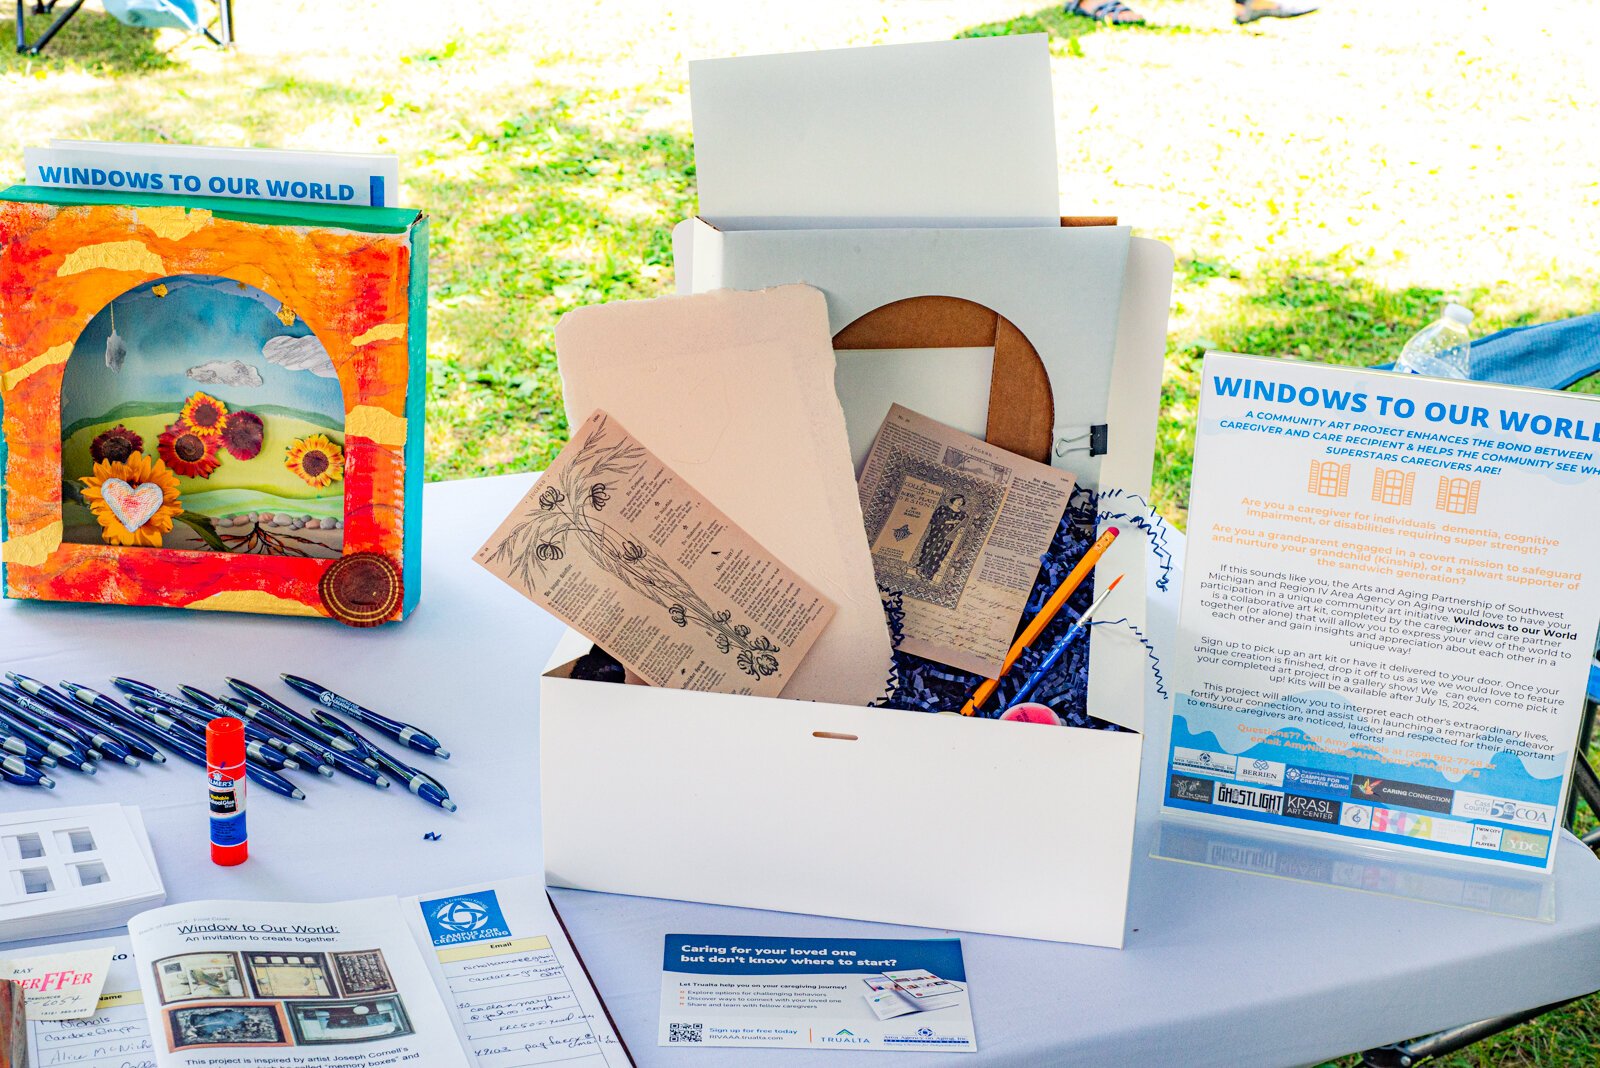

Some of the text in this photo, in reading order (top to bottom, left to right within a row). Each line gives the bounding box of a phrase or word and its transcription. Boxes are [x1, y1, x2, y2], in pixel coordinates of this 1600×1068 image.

[38, 165, 354, 200] WINDOWS TO OUR WORLD
[1214, 376, 1366, 414] WINDOWS
[1375, 395, 1414, 419] TO
[1424, 401, 1489, 428] OUR
[1246, 410, 1593, 460] A COMMUNITY ART PROJECT ENHANCES THE BOND BETWEEN
[1220, 420, 1282, 435] CAREGIVER
[1284, 428, 1309, 439] AND
[1312, 432, 1342, 443] CARE
[1345, 436, 1404, 451] RECIPIENT
[1406, 444, 1413, 452] &
[1416, 445, 1453, 457] HELPS
[1456, 450, 1478, 460] THE
[1481, 453, 1554, 470] COMMUNITY
[1555, 463, 1577, 473] SEE
[1325, 446, 1502, 475] SUPERSTARS CAREGIVERS ARE!
[1242, 497, 1261, 508] Are
[1263, 502, 1284, 512] you
[1297, 506, 1350, 519] caregiver
[1352, 512, 1369, 522] for
[1372, 514, 1436, 530] individuals
[1442, 523, 1501, 540] dementia,
[1503, 533, 1560, 546] cognitive
[1246, 508, 1315, 527] impairment,
[1332, 519, 1395, 535] disabilities
[1397, 529, 1451, 544] requiring
[1454, 536, 1487, 547] super
[1490, 540, 1548, 554] strength?
[1200, 582, 1263, 596] participation
[1266, 589, 1275, 598] in
[1287, 593, 1322, 605] unique
[1325, 599, 1384, 615] community
[1387, 607, 1400, 615] art
[1404, 610, 1451, 623] initiative.
[1453, 614, 1504, 629] Windows
[1507, 622, 1518, 631] to
[1521, 626, 1540, 634] our
[1543, 627, 1577, 639] World
[1350, 640, 1412, 656] unique way!
[1270, 675, 1480, 712] up! Kits will be available after July 15, 2024.
[1187, 697, 1555, 760] to ensure caregivers are noticed, lauded and respected for their important
[1350, 731, 1384, 742] efforts!
[1242, 769, 1278, 780] BERRIEN
[1218, 786, 1283, 810] GHOSTLIGHT
[1382, 788, 1450, 803] CARING CONNECTION
[1288, 796, 1333, 814] KRASL
[1464, 803, 1490, 814] County
[1303, 810, 1332, 820] CENTER
[1516, 808, 1547, 822] COA
[1510, 840, 1539, 851] YDC
[178, 924, 238, 934] Window
[261, 924, 287, 933] Our
[291, 925, 338, 933] World:
[440, 931, 478, 939] CAMPUS
[434, 935, 477, 944] CREATIVE
[681, 944, 726, 956] Caring
[730, 945, 751, 954] for
[754, 948, 786, 956] your
[790, 946, 827, 956] loved
[680, 955, 898, 967] but don't know where to start?
[368, 1047, 408, 1058] Cornell's
